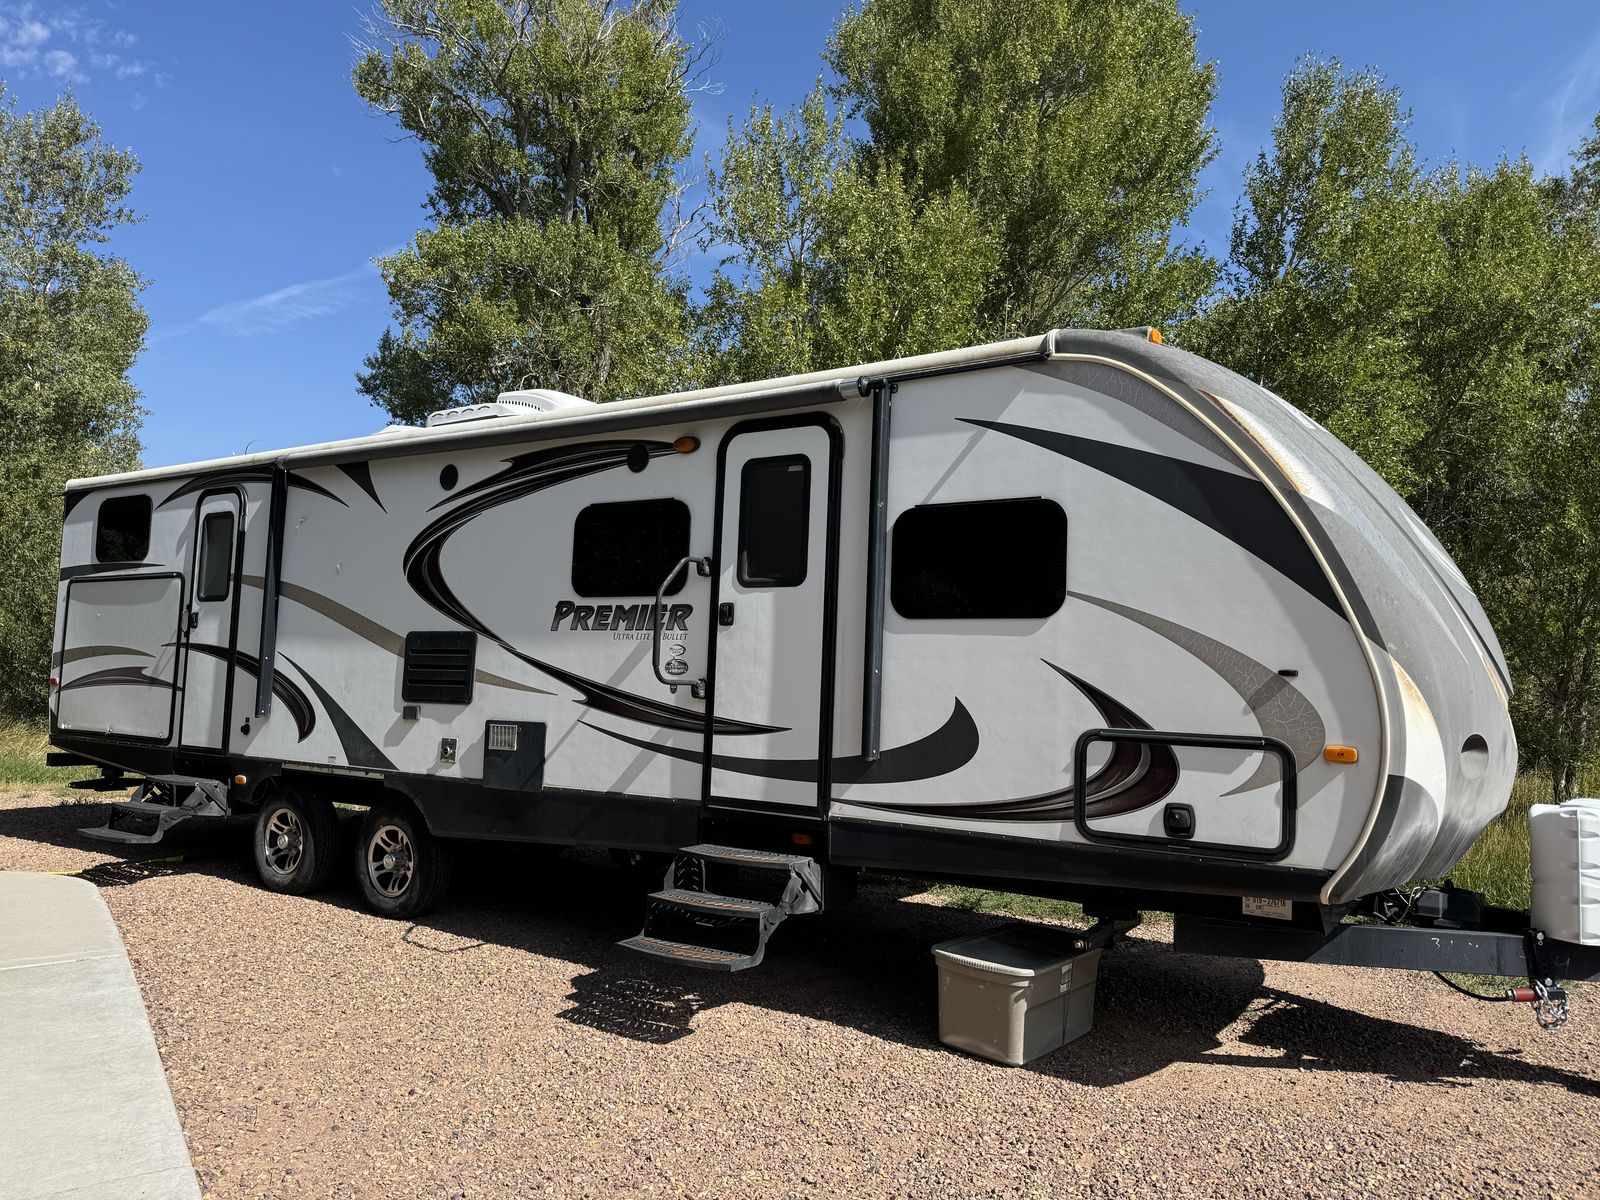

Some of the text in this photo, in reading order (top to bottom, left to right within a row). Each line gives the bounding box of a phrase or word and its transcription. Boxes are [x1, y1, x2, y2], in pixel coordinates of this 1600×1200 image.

[551, 600, 693, 632] PREMIER
[613, 632, 634, 641] ULTRA
[635, 632, 651, 641] LITE
[662, 632, 688, 641] BULLET
